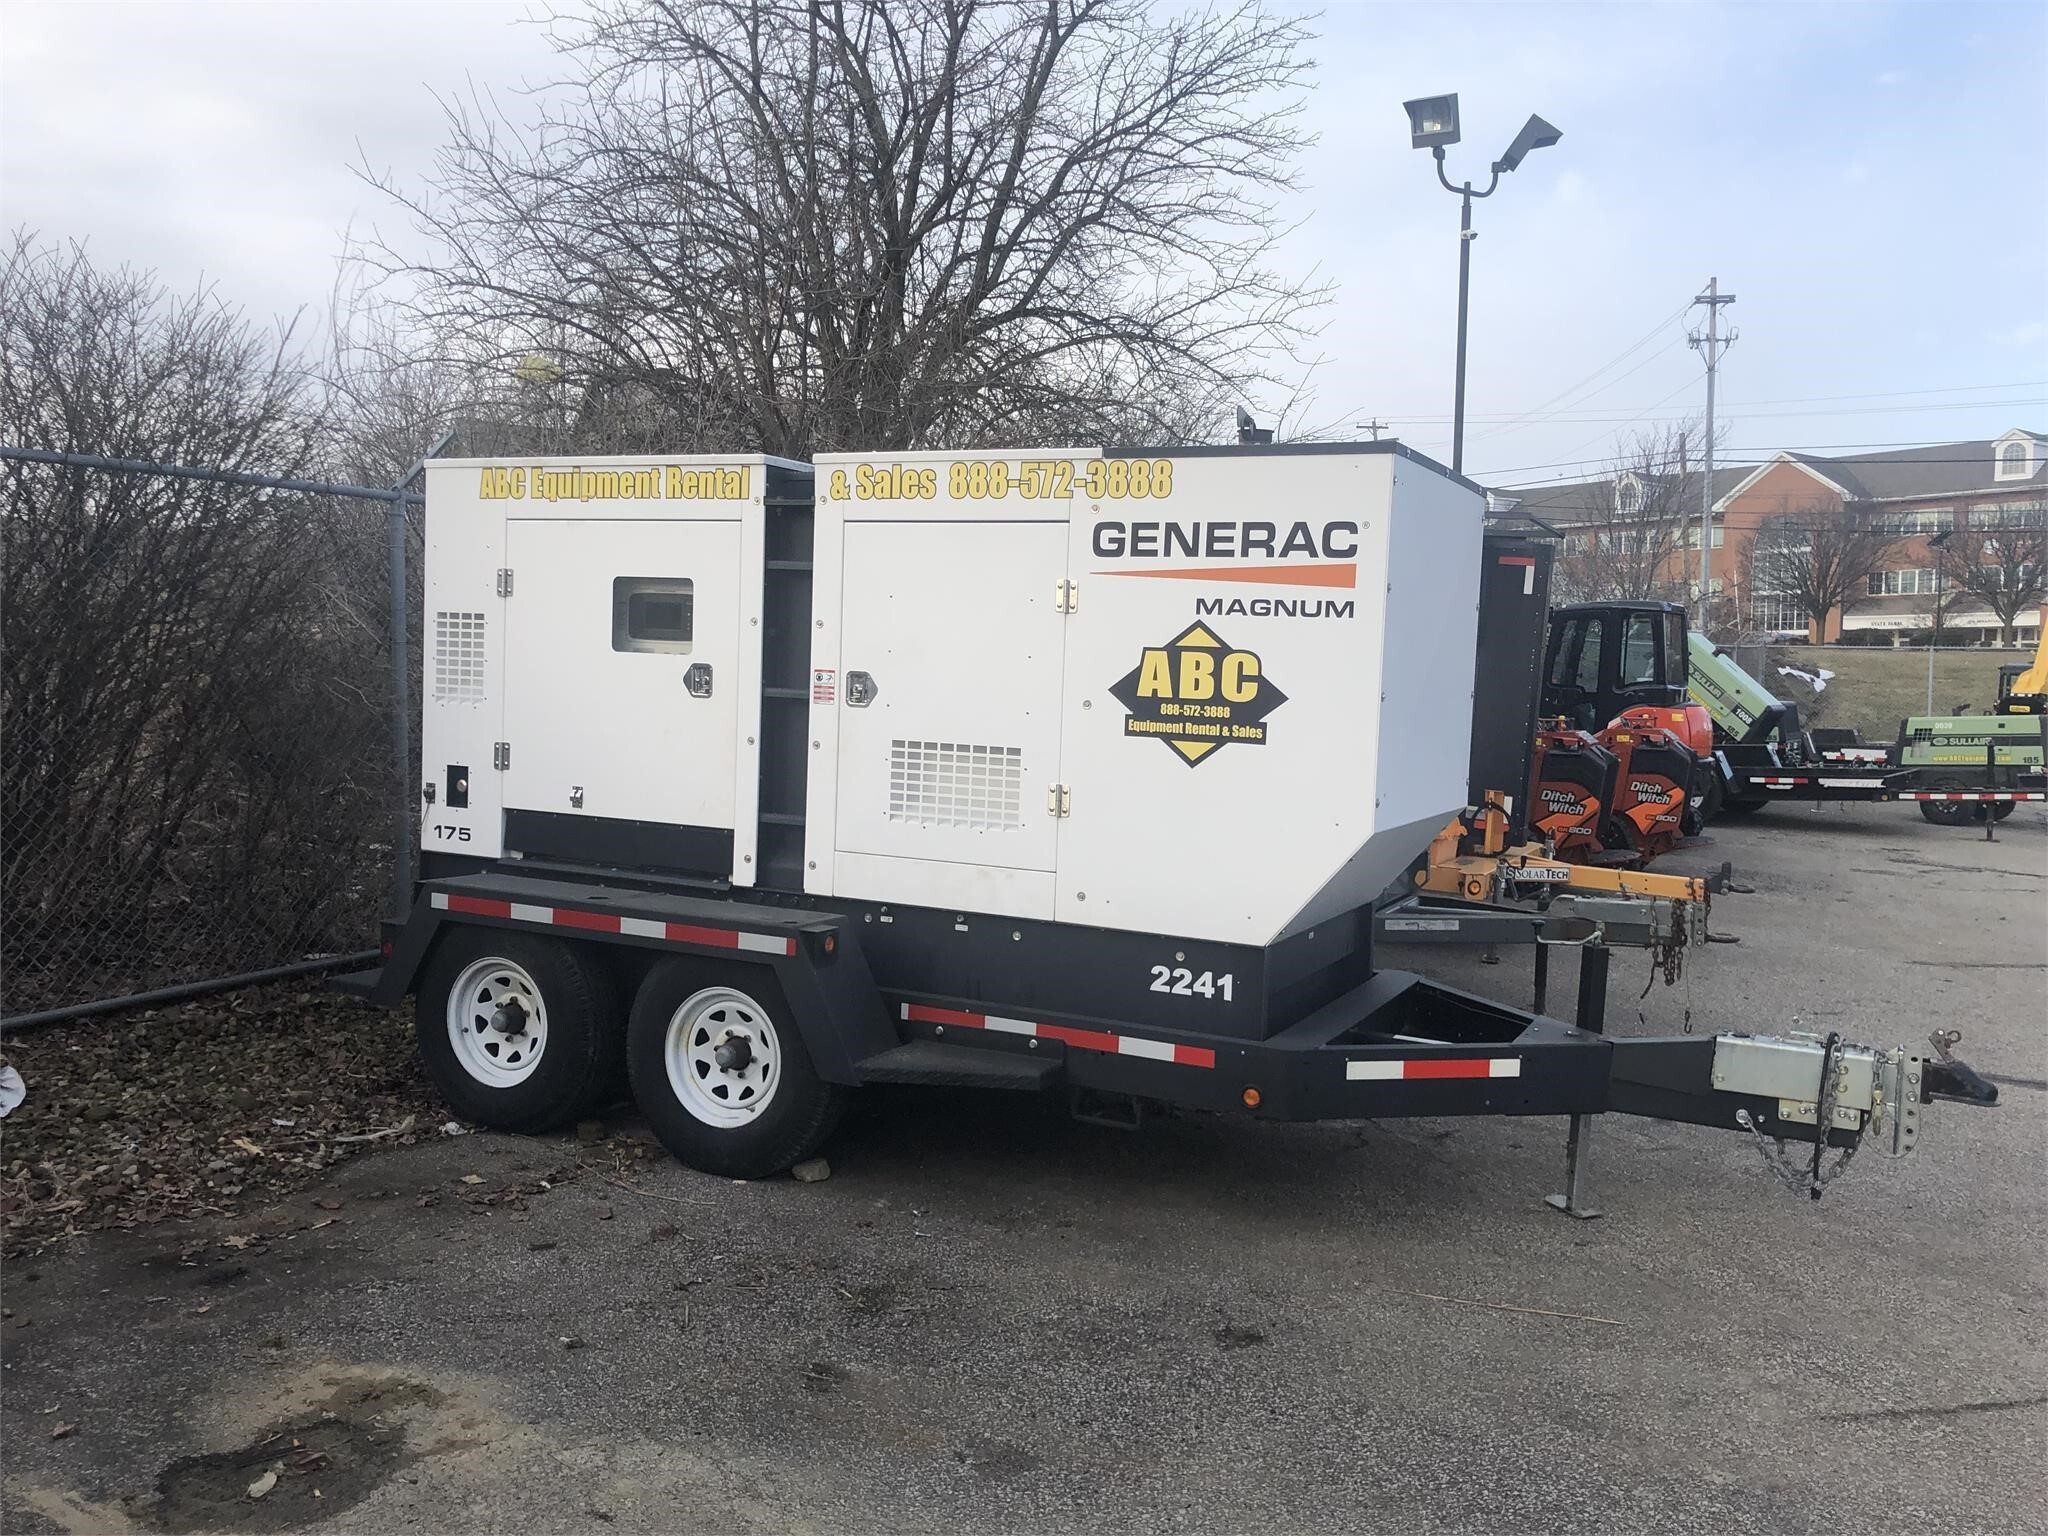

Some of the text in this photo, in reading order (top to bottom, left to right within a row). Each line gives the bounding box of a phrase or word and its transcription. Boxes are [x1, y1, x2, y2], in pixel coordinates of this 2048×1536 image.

[479, 465, 750, 502] ABC Equipment Rental
[830, 459, 1173, 500] & Sales 888-572-3888
[1092, 521, 1359, 559] GENERAC
[1195, 598, 1355, 619] MAGNUM
[1136, 650, 1259, 703] ABC
[1693, 671, 1722, 699] SULLAIR
[1160, 703, 1231, 719] 888-572-3888
[1735, 708, 1753, 725] 1008
[1128, 719, 1263, 739] Equipment Rental & Sales
[1727, 725, 1740, 738] 185
[1949, 737, 1990, 746] SULLAIR
[2023, 756, 2039, 764] 185
[1631, 781, 1662, 794] Ditch
[1541, 790, 1576, 803] Ditch
[1637, 792, 1671, 804] Witch
[1549, 802, 1584, 815] Witch
[434, 825, 471, 842] 175
[1149, 965, 1233, 1001] 2241
